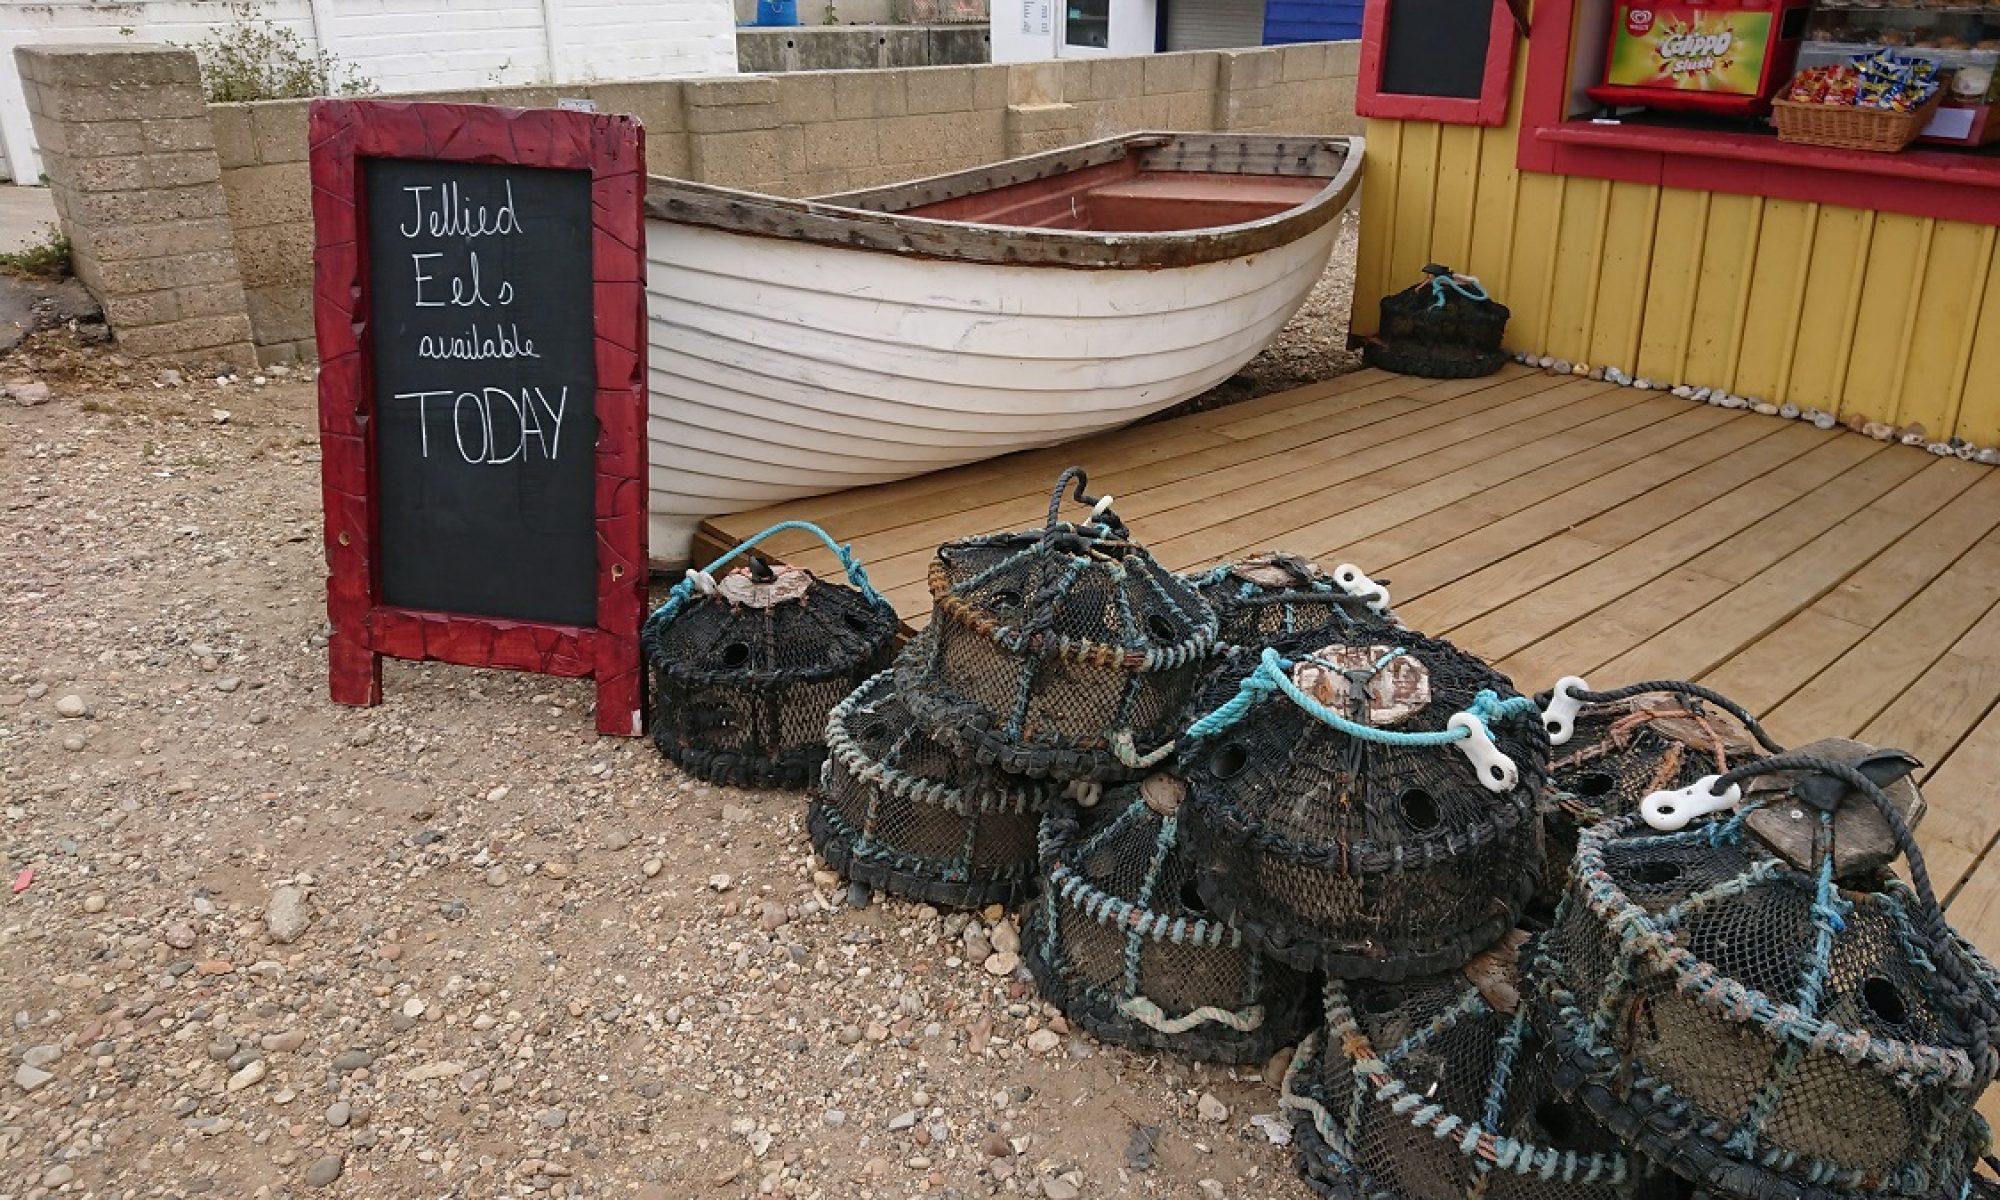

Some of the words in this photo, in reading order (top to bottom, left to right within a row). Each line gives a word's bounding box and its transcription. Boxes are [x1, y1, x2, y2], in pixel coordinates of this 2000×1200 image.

[400, 179, 523, 238] Jellied
[411, 251, 513, 307] Eels
[419, 323, 541, 360] available
[394, 386, 568, 464] TODAY
